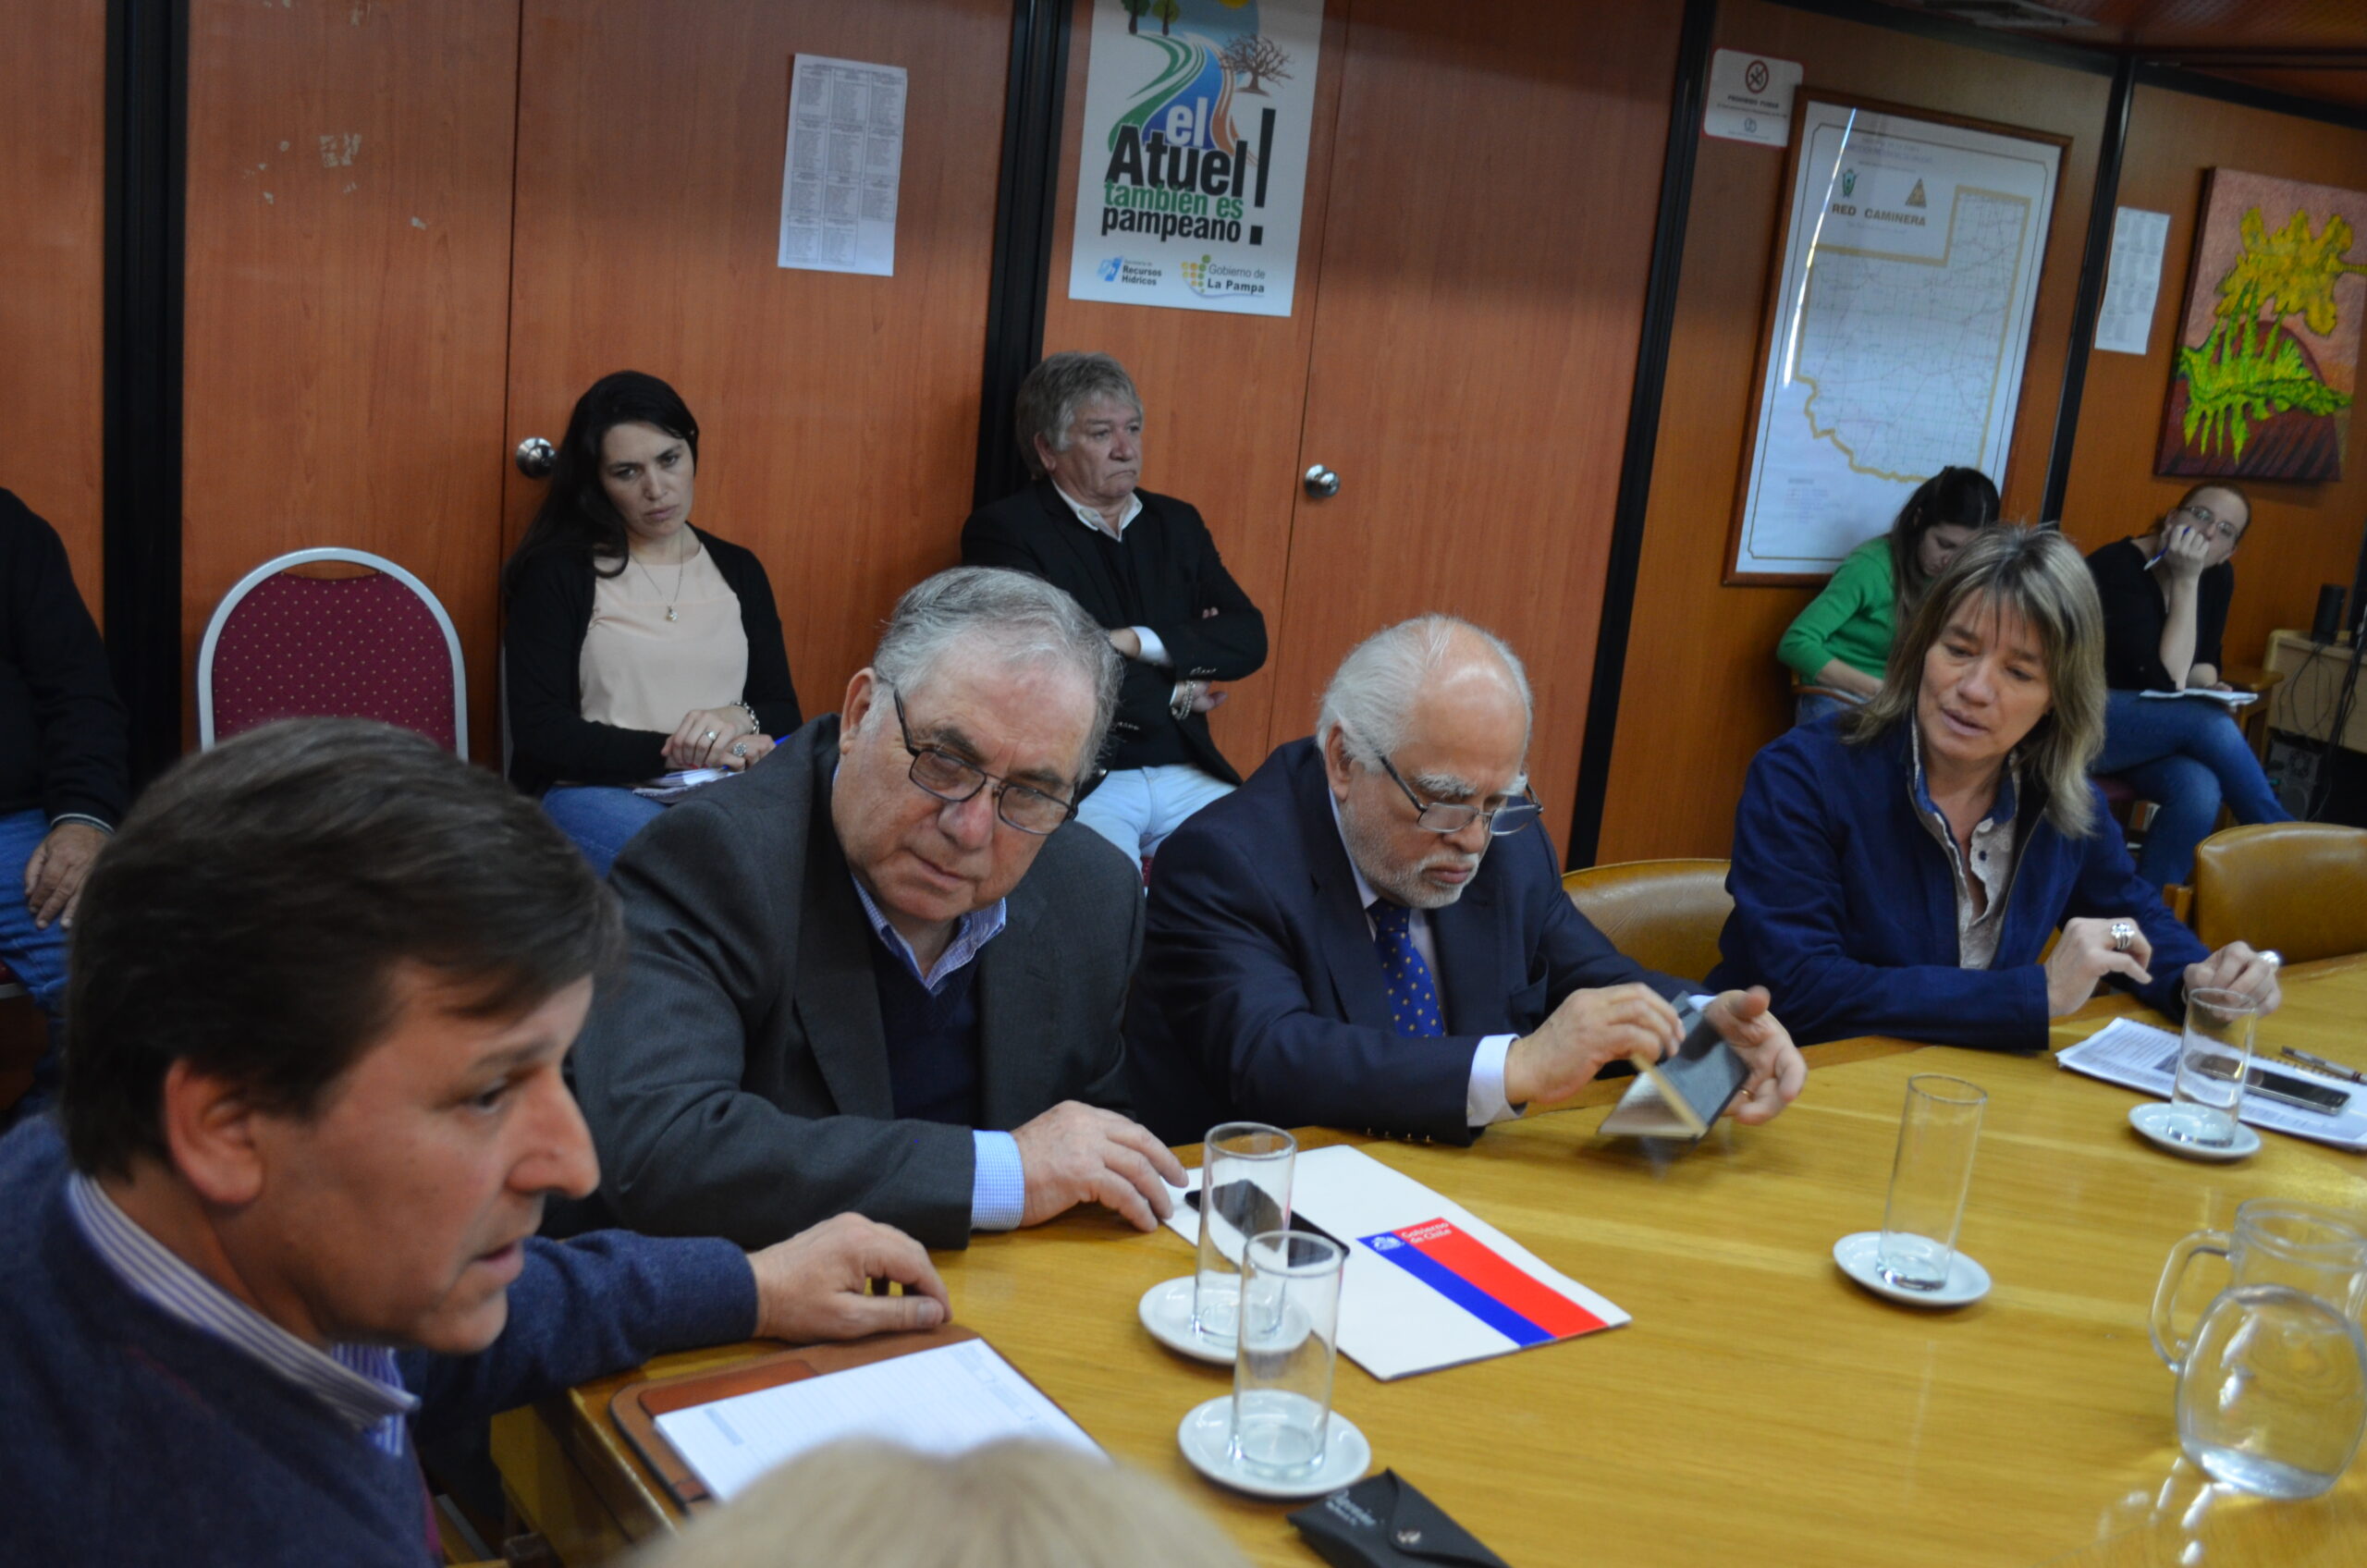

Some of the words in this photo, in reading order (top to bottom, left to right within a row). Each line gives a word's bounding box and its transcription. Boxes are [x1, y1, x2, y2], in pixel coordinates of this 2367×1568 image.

[1165, 96, 1208, 147] el
[1104, 124, 1248, 198] Atuel
[1104, 178, 1208, 215] también
[1216, 196, 1244, 220] es
[1101, 206, 1242, 242] pampeano
[1832, 202, 1857, 216] RED
[1864, 207, 1927, 227] CAMINERA
[1122, 264, 1162, 277] Recursos
[1208, 263, 1253, 277] Gobierno
[1255, 268, 1266, 280] de
[1208, 278, 1221, 289] La
[1225, 279, 1265, 295] Pampa
